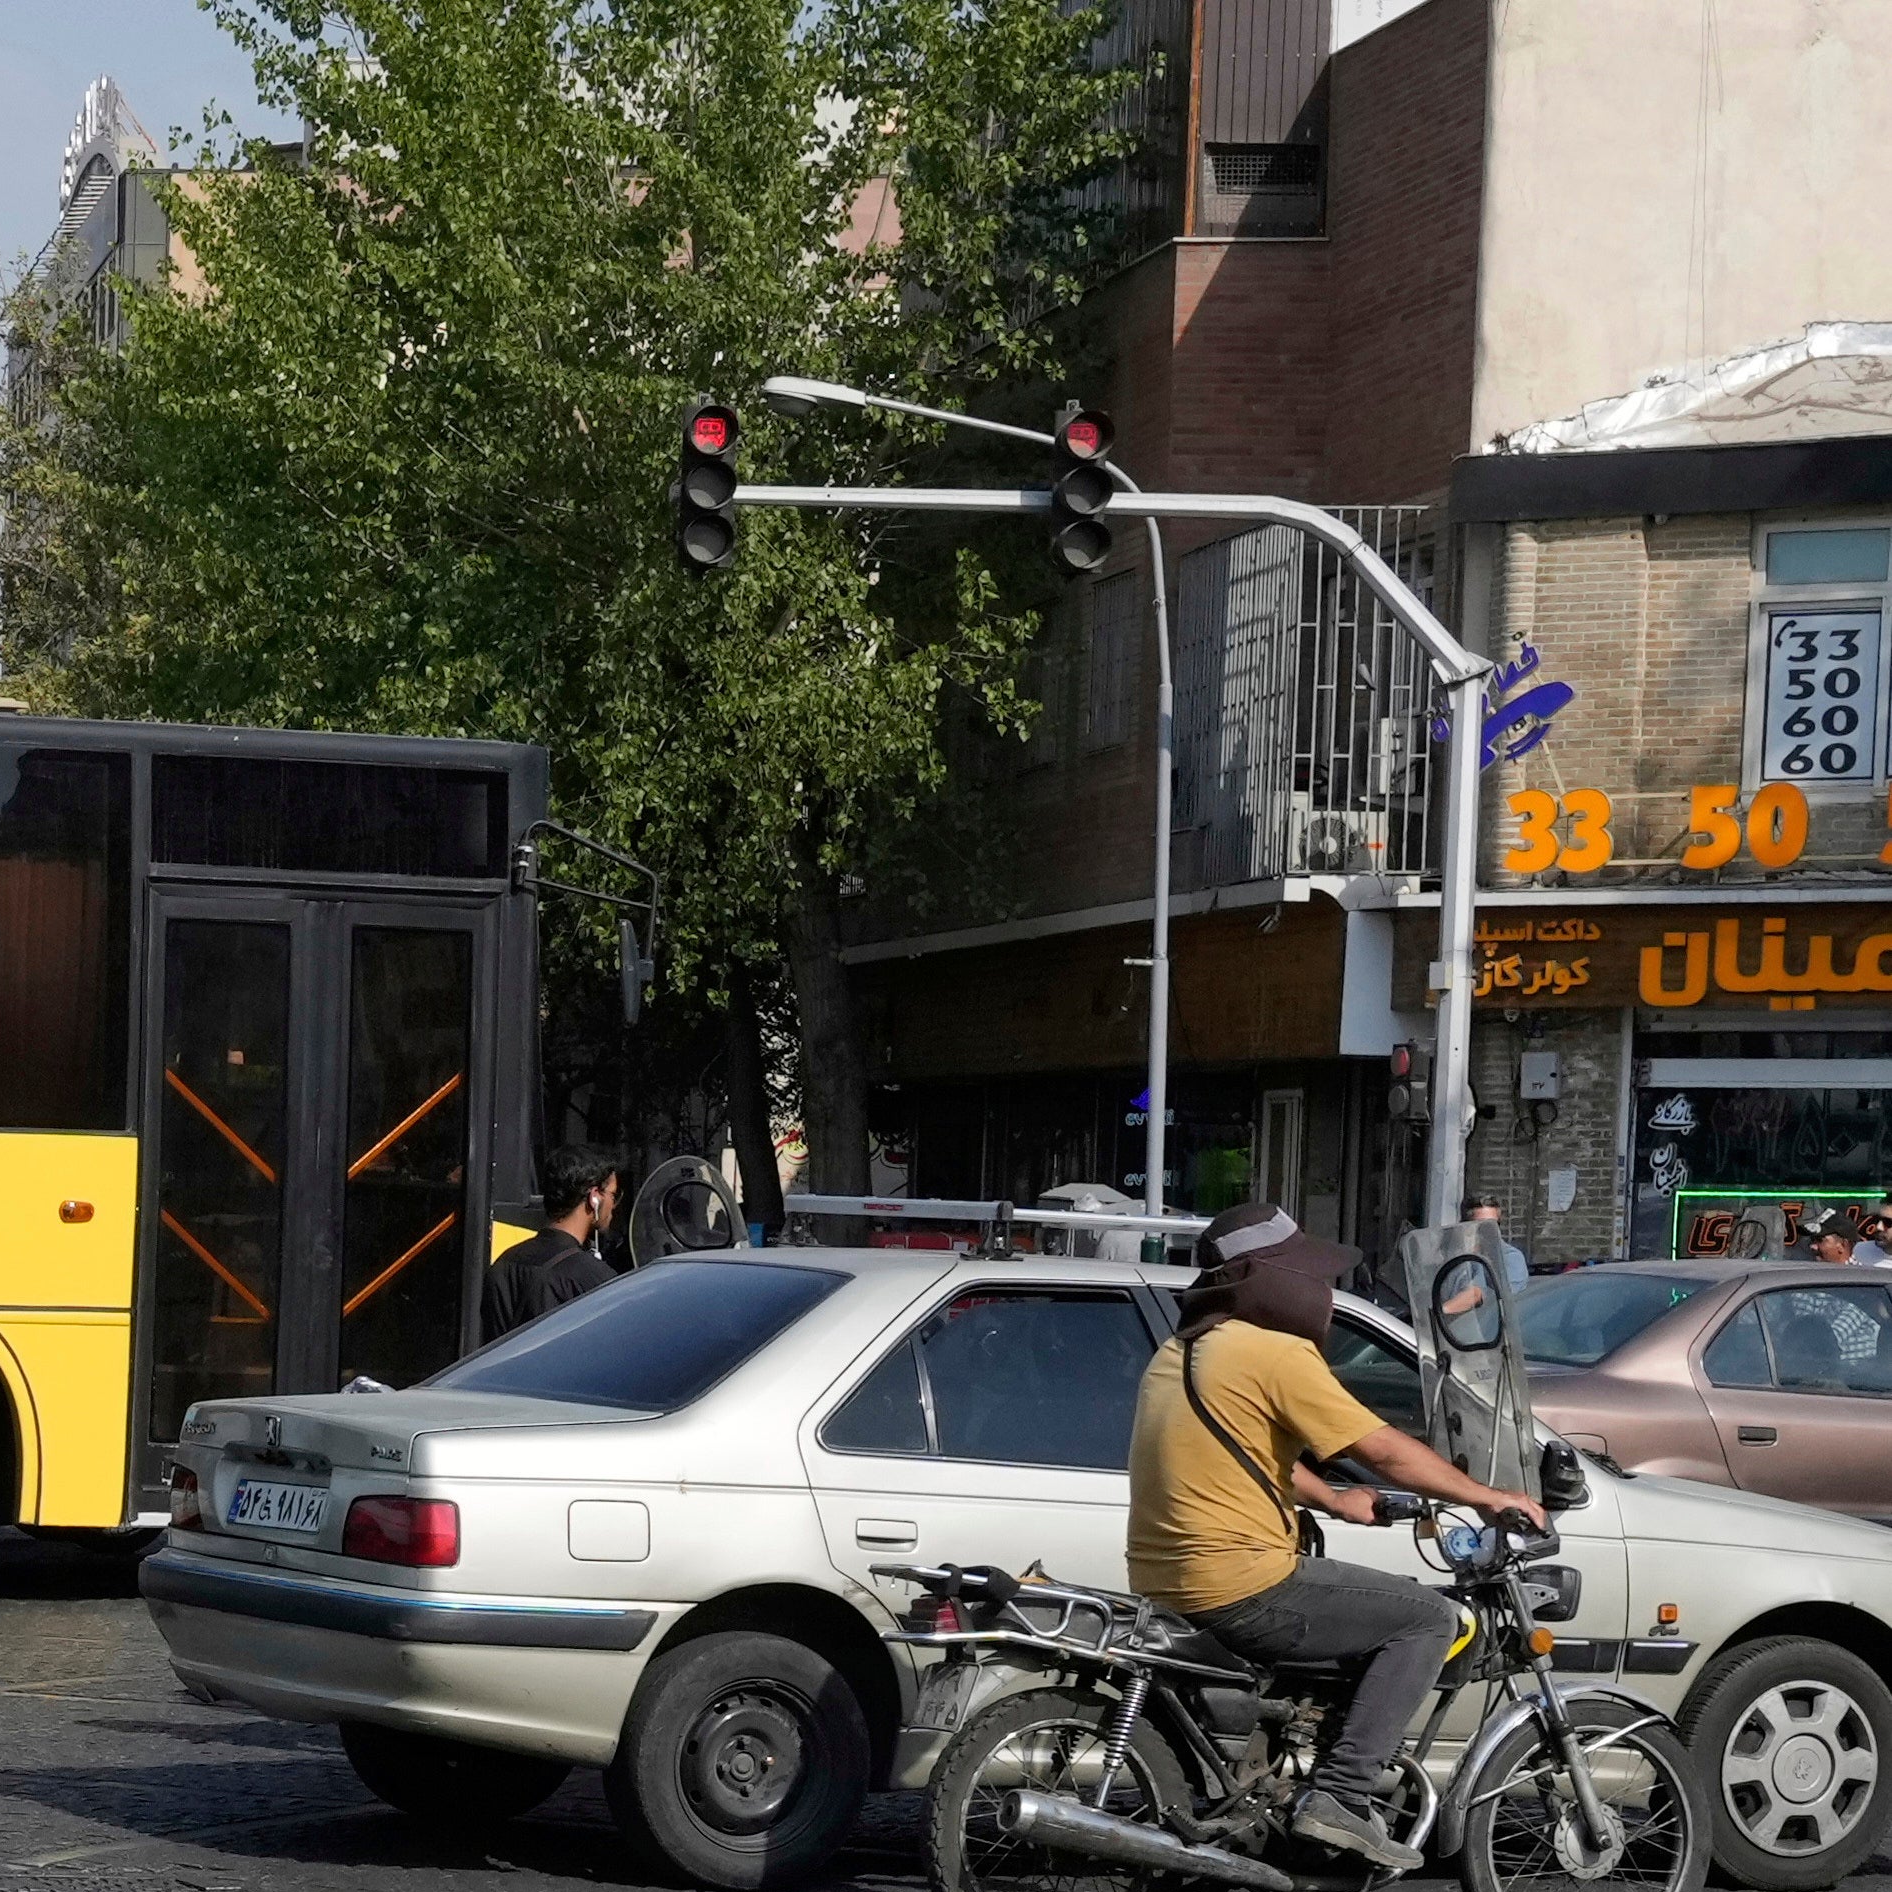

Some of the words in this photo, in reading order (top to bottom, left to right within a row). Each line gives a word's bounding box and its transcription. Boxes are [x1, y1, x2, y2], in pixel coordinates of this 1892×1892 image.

[1786, 628, 1862, 663] 33
[1784, 666, 1862, 701] 50
[1781, 704, 1860, 740] 60
[1779, 742, 1858, 776] 60
[1503, 787, 1615, 875] 33
[1681, 781, 1810, 871] 50
[1536, 917, 1602, 942] داکت
[1522, 956, 1591, 996] کولر
